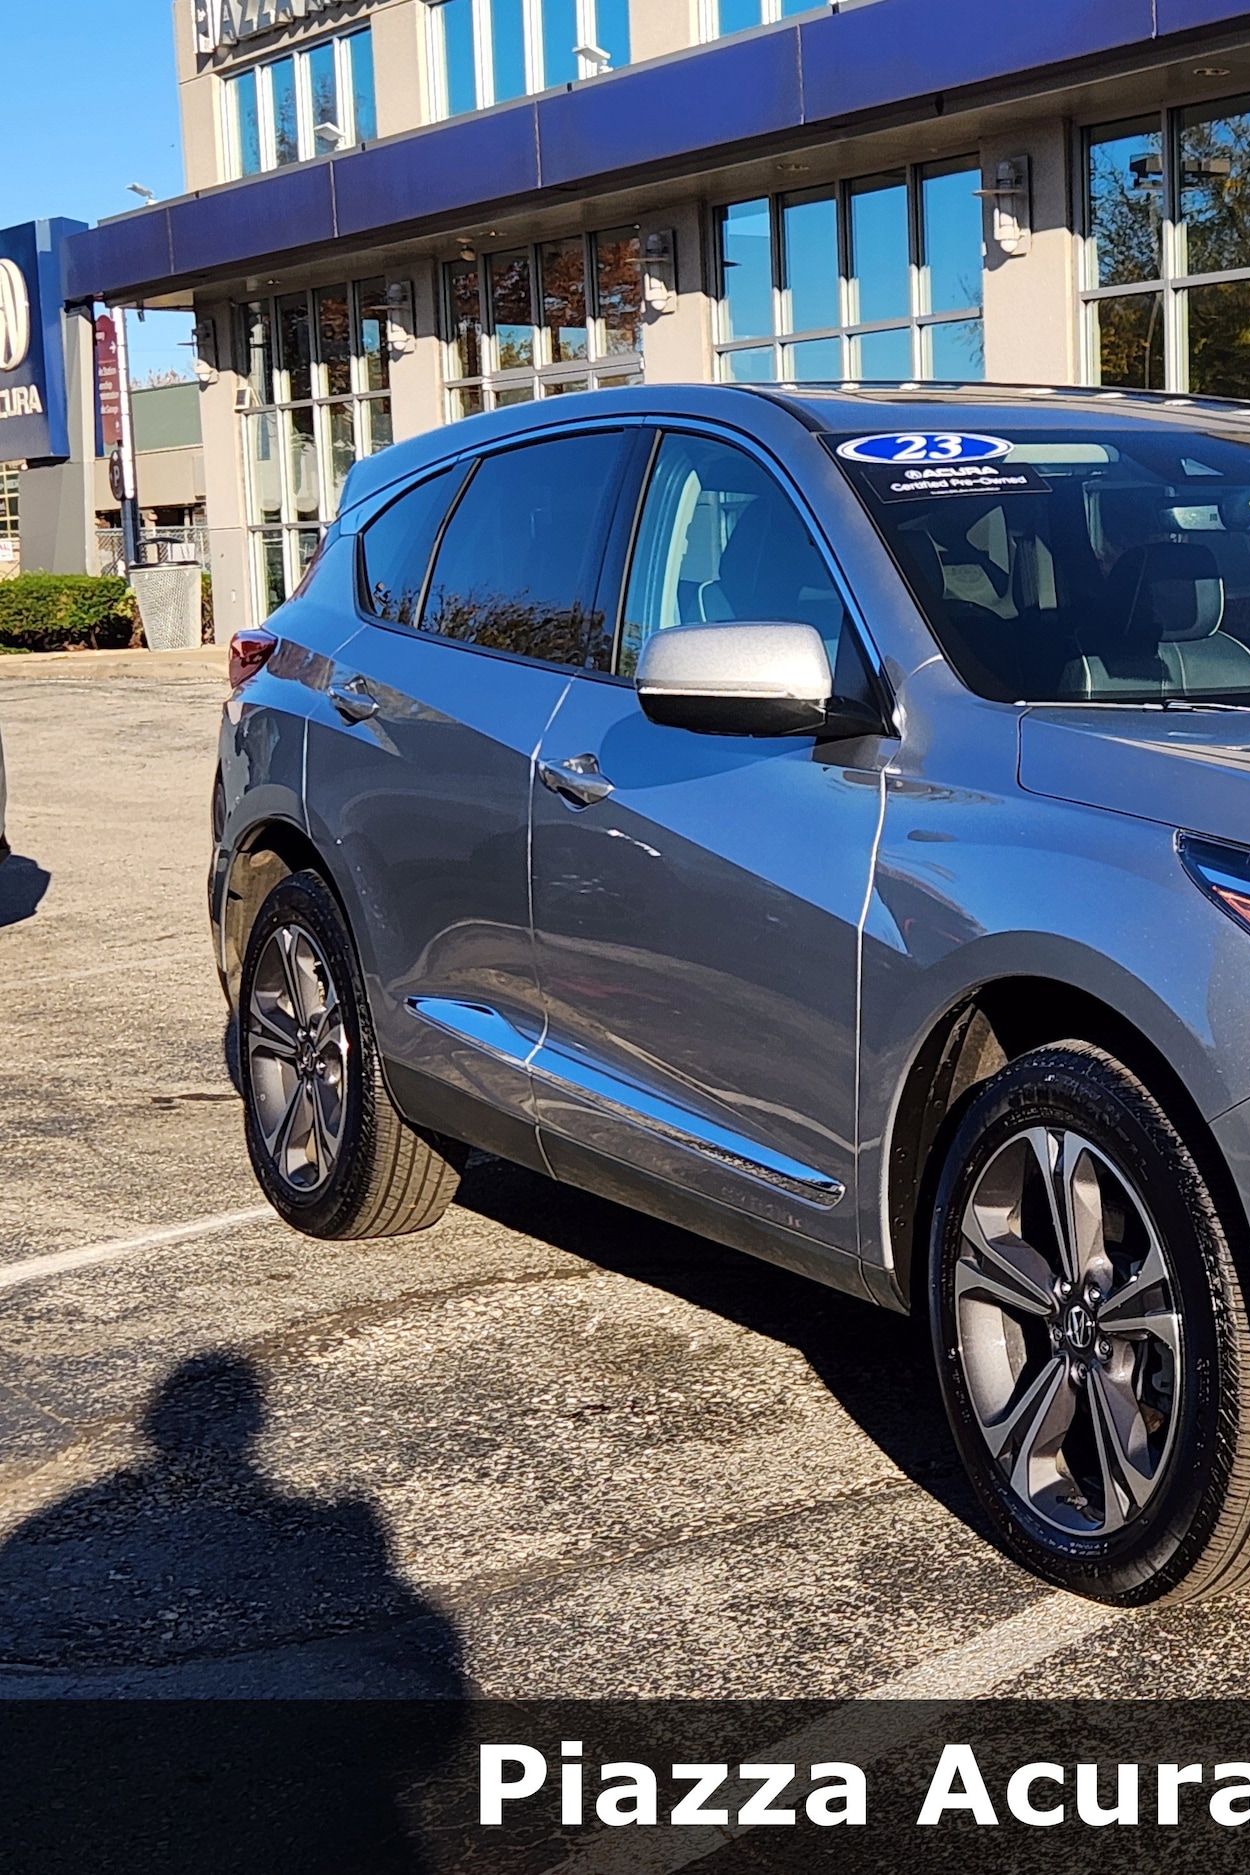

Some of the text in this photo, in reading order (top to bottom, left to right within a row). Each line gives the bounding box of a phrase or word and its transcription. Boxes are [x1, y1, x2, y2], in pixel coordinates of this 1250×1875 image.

[892, 435, 962, 460] 23
[922, 465, 999, 478] ACURA
[890, 479, 949, 492] Certified
[950, 476, 1028, 487] Pre-Owned
